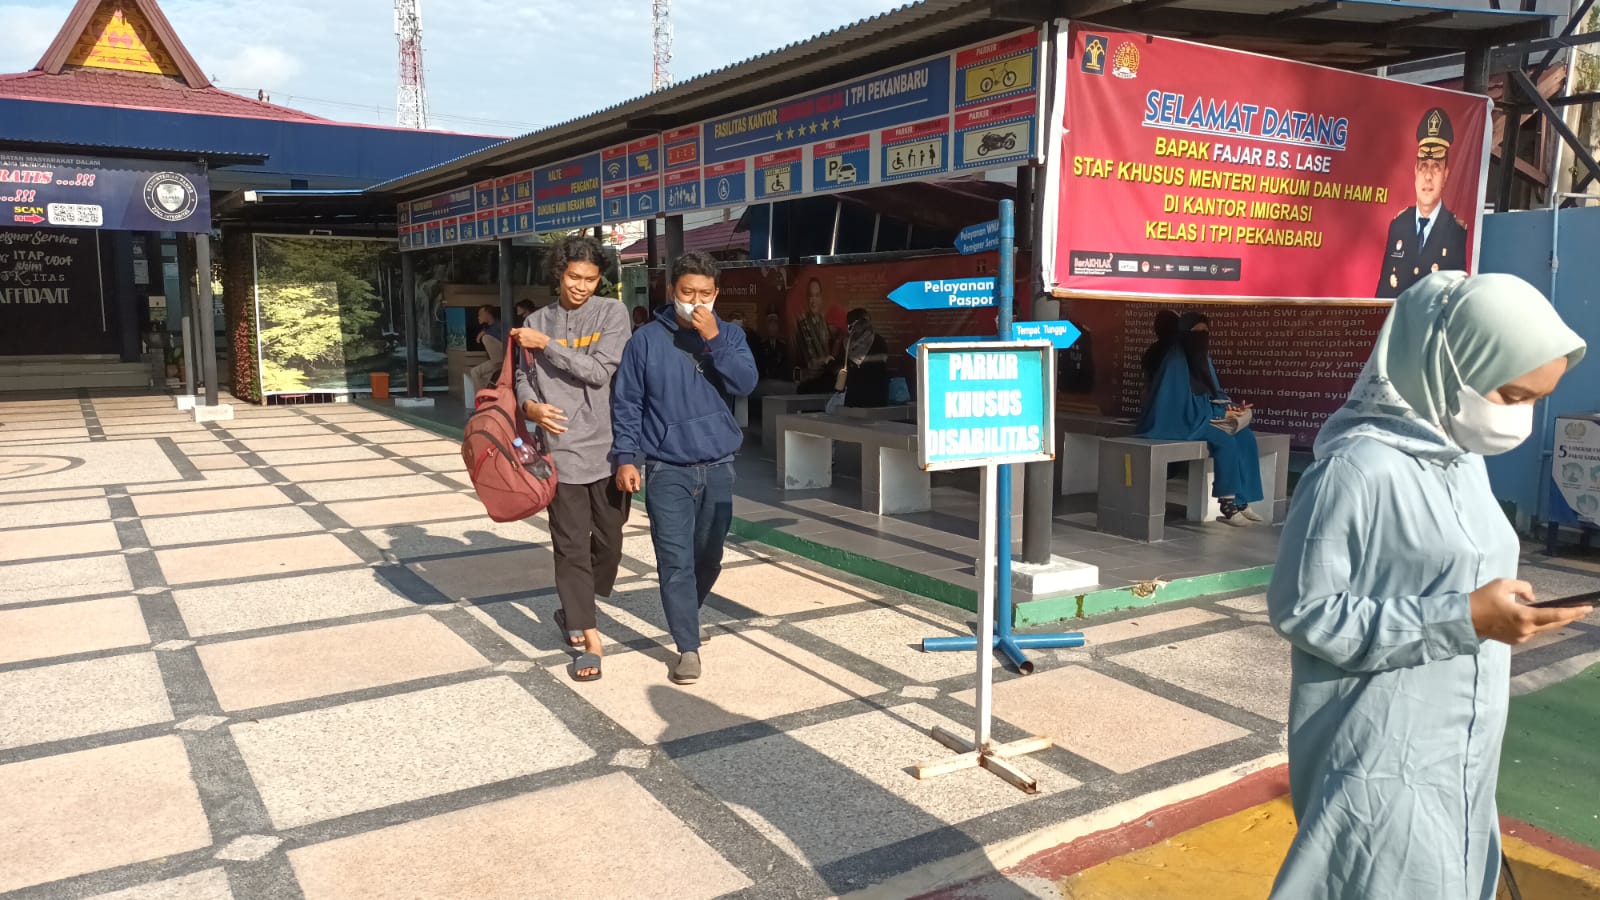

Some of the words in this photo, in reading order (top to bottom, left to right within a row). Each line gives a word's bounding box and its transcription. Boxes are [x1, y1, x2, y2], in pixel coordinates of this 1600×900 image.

[714, 114, 748, 139] FASILITAS
[748, 108, 778, 133] KANTOR
[845, 89, 849, 106] I
[851, 86, 866, 105] TPI
[868, 67, 929, 101] PEKANBARU
[1144, 89, 1259, 134] SELAMAT
[1261, 107, 1349, 146] DATANG
[1155, 136, 1211, 161] BAPAK
[1213, 143, 1262, 166] FAJAR
[1265, 150, 1292, 169] B.S.
[1295, 153, 1332, 173] LASE
[570, 177, 599, 194] PENGANTAR
[1073, 155, 1114, 178] STAF
[1117, 161, 1185, 187] KHUSUS
[1188, 168, 1257, 192] MENTERI
[1259, 175, 1311, 198] HUKUM
[1313, 181, 1342, 200] DAN
[1344, 184, 1373, 203] HAM
[1375, 187, 1389, 204] RI
[13, 206, 44, 214] SCAN
[1163, 194, 1180, 214] DI
[1183, 195, 1247, 218] KANTOR
[1250, 200, 1313, 222] IMIGRASI
[1145, 220, 1198, 242] KELAS
[1201, 224, 1206, 241] I
[1209, 224, 1233, 243] TPI
[1235, 226, 1323, 248] PEKANBARU
[924, 280, 994, 293] Pelayanan
[948, 295, 994, 307] Paspor
[1242, 309, 1270, 318] Allah
[1300, 309, 1322, 317] dan
[1217, 319, 1239, 327] baik
[1242, 319, 1269, 329] pasti
[1272, 318, 1314, 327] dibalas
[1318, 318, 1365, 328] dengan
[1016, 325, 1040, 337] Tempat
[1043, 324, 1067, 336] Tunggu
[1230, 329, 1262, 337] buruk
[1265, 329, 1294, 339] pasti
[1297, 328, 1341, 337] dibalas
[1236, 338, 1264, 346] akhir
[1267, 339, 1289, 347] dan
[1292, 338, 1372, 348] menciptakan
[1236, 349, 1302, 357] kemudahan
[1305, 349, 1354, 359] layanan
[949, 352, 1018, 381] PARKIR
[1249, 359, 1273, 367] take
[1275, 358, 1308, 367] home
[1310, 359, 1334, 370] pay
[1336, 360, 1366, 370] yang
[1262, 368, 1314, 379] terhadap
[1277, 388, 1321, 399] dengan
[944, 389, 1022, 419] KHUSUS
[1267, 407, 1309, 419] berfikir
[928, 424, 1040, 457] DISABILITAS
[1558, 444, 1568, 458] 5
